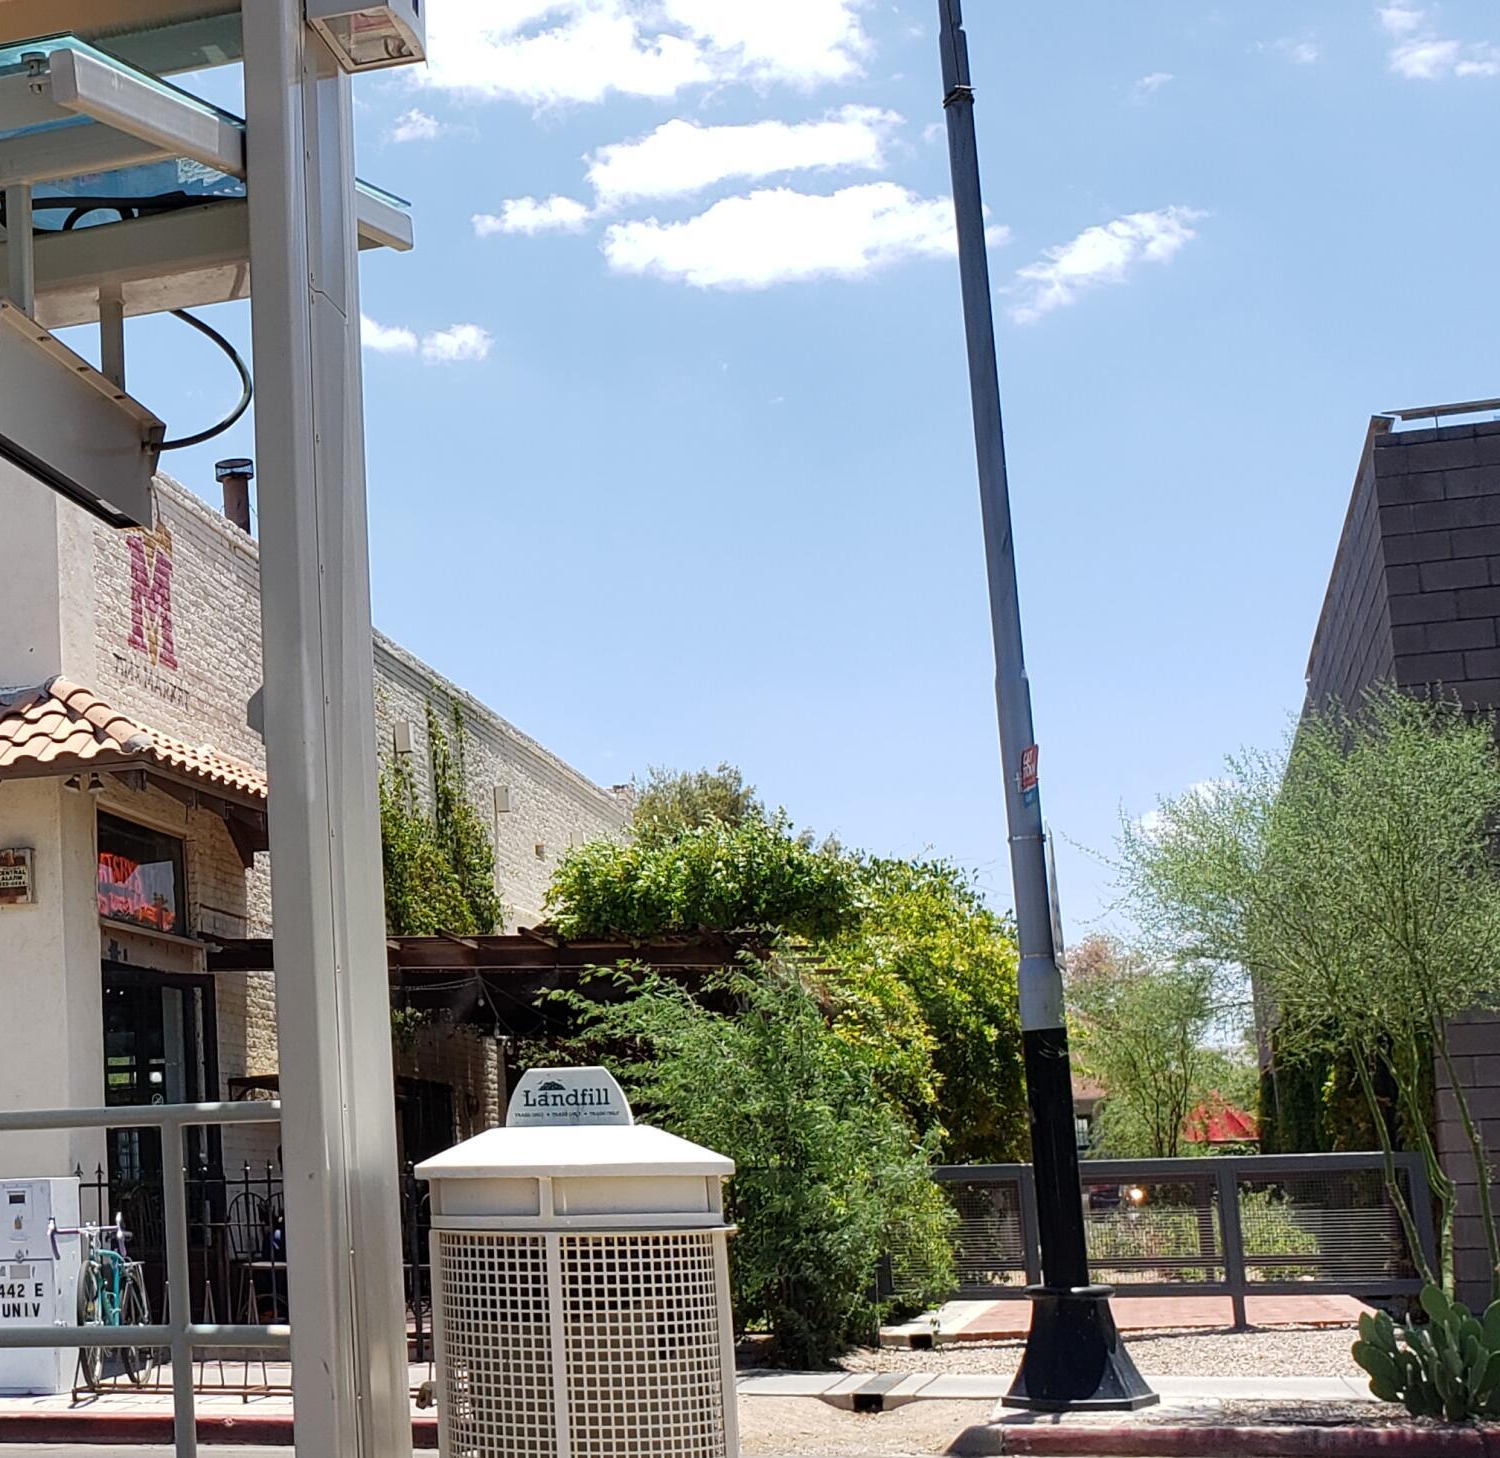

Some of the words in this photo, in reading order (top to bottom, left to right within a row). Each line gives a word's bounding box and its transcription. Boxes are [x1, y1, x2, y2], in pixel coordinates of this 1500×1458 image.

[523, 1088, 611, 1107] Landfill
[35, 1283, 44, 1297] E
[2, 1303, 41, 1318] UNIV
